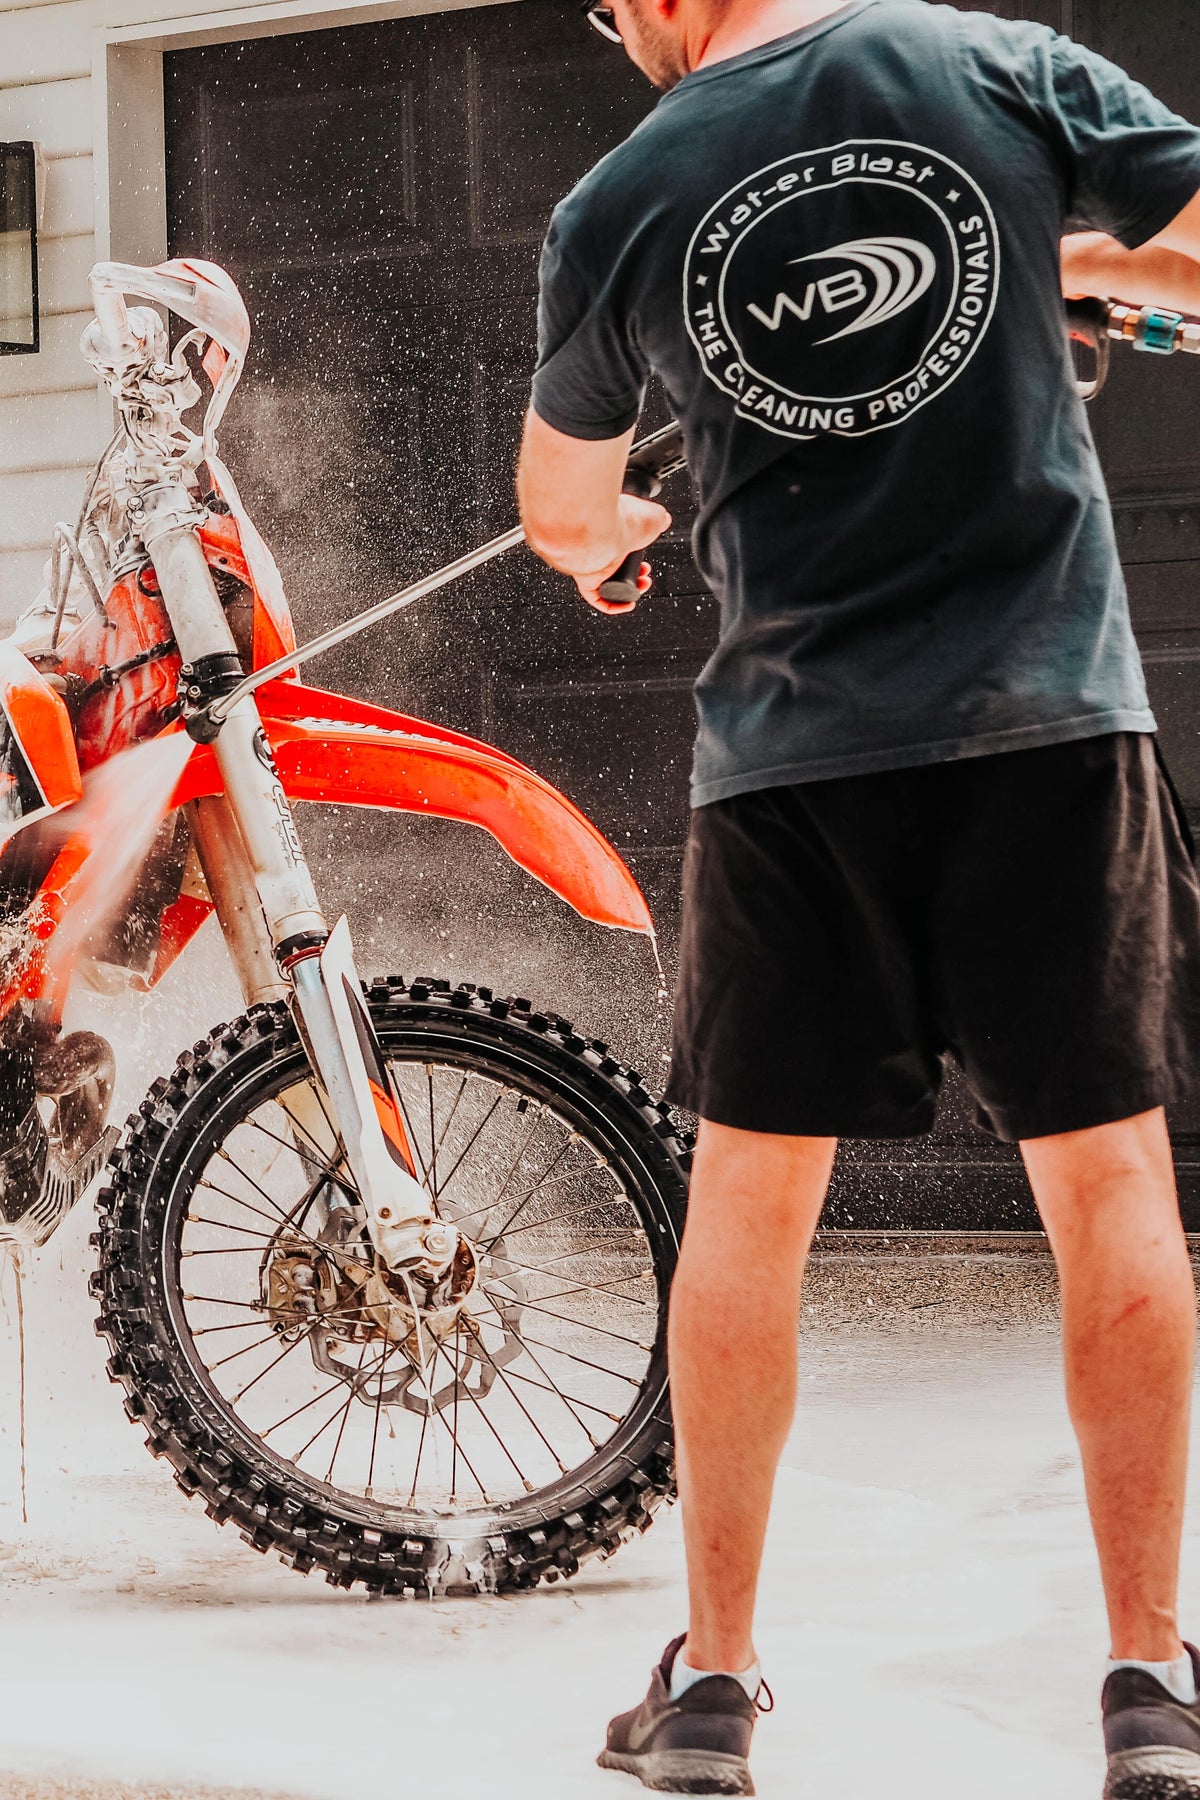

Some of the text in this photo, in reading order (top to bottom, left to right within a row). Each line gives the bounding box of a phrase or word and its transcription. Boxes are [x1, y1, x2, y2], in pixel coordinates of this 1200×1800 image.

[831, 152, 936, 183] Blast
[694, 301, 729, 360] THE
[867, 214, 990, 421] PROFESSIONALS
[746, 268, 868, 331] WB
